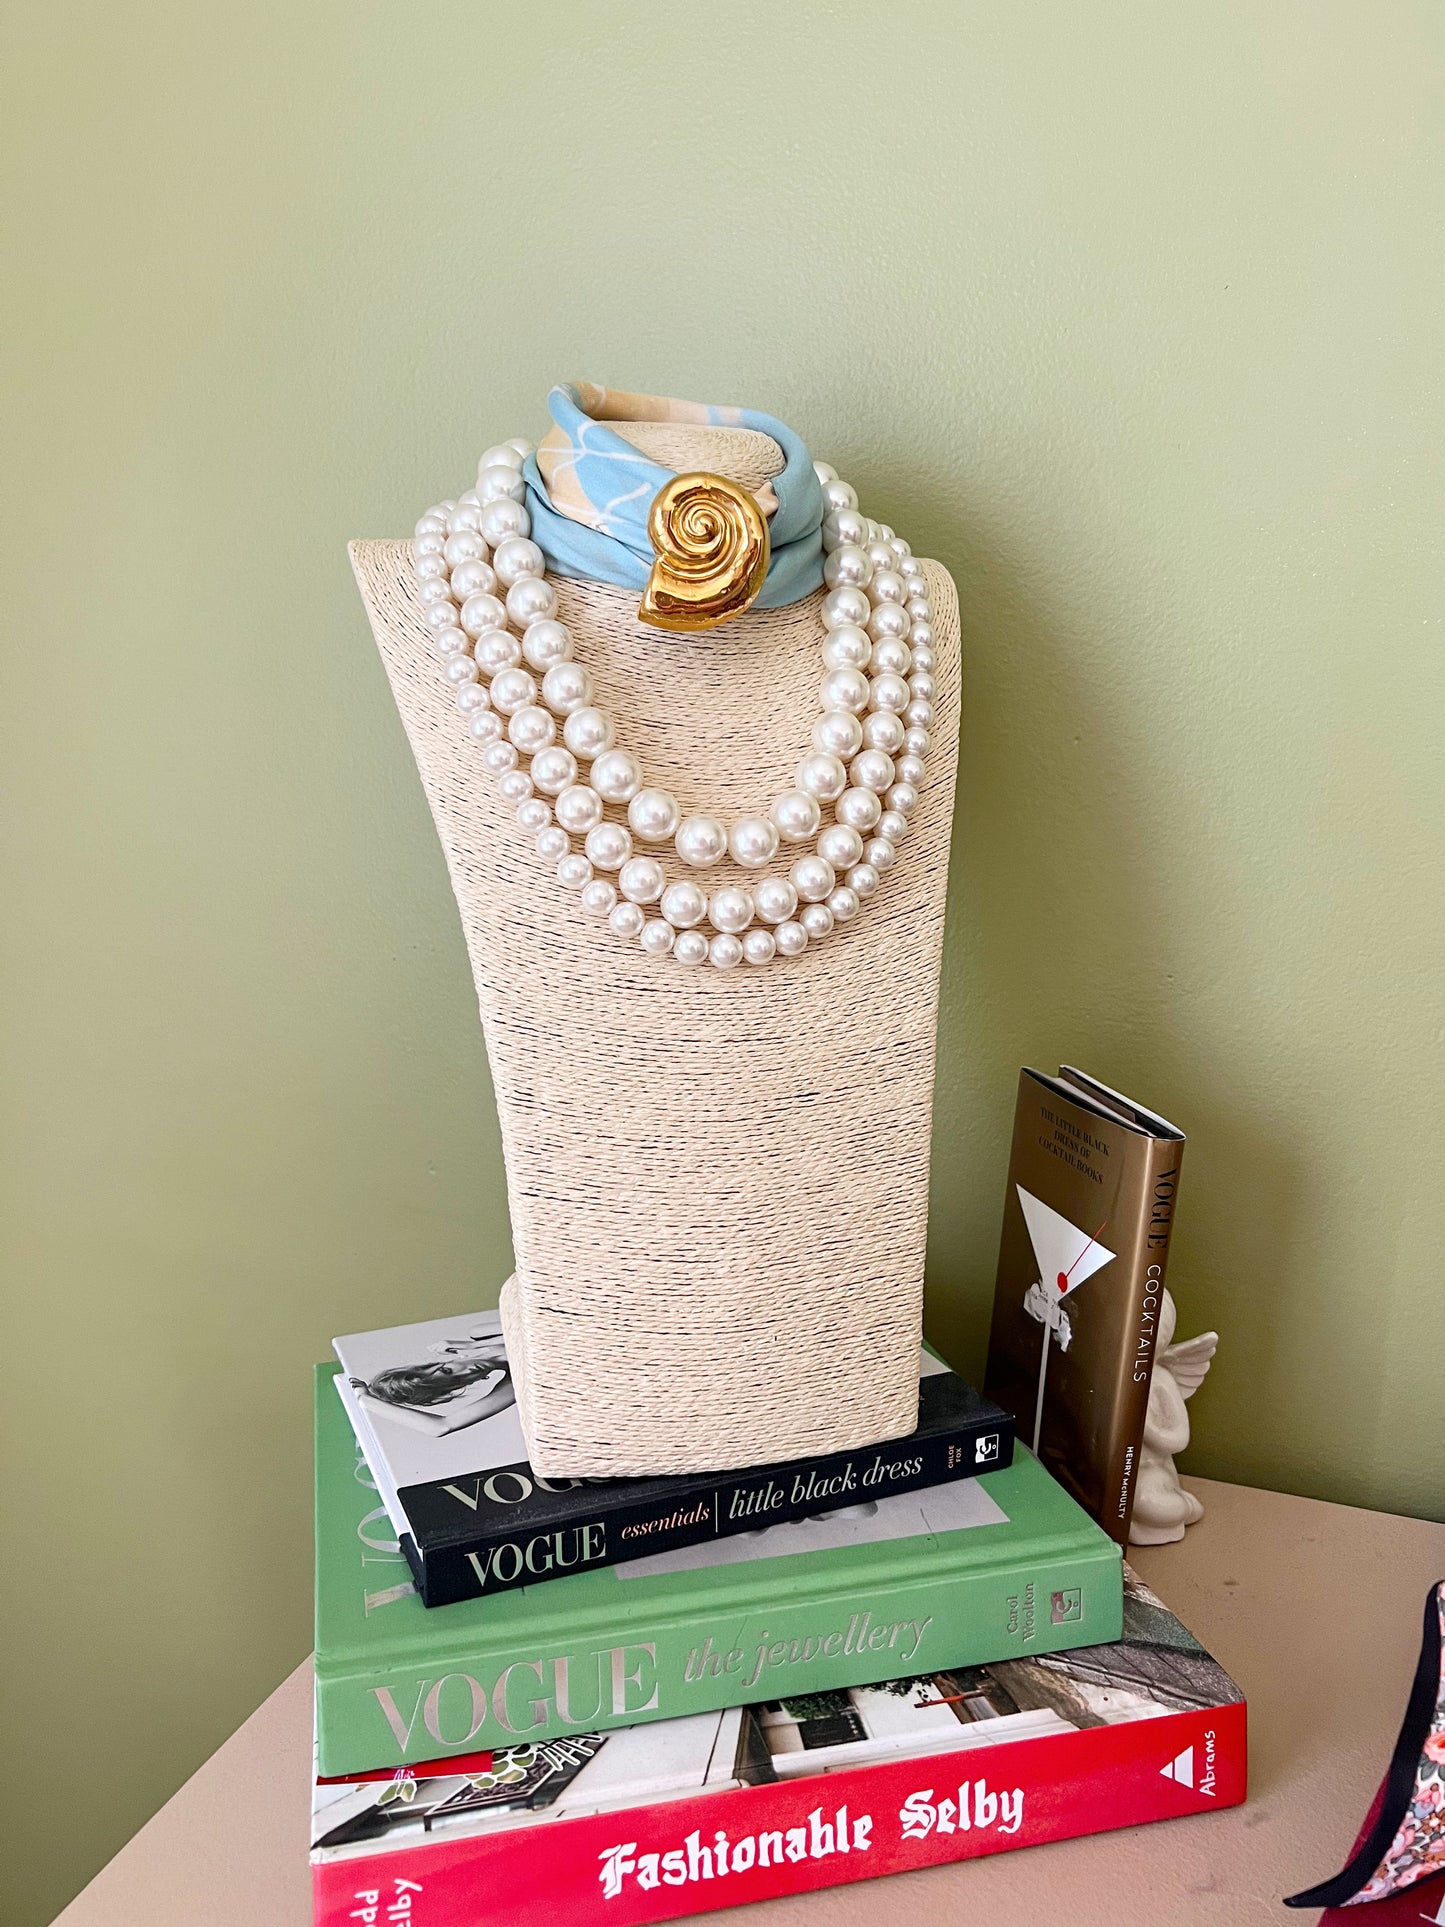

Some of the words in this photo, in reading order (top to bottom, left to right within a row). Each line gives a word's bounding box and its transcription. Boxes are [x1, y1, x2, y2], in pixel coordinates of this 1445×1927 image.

[1041, 1107, 1055, 1123] THE
[1055, 1116, 1081, 1139] LITTLE
[1083, 1131, 1111, 1156] BLACK
[1054, 1130, 1079, 1152] DRESS
[1080, 1146, 1091, 1159] OF
[1038, 1136, 1076, 1167] COCKTAIL
[1077, 1159, 1104, 1184] BOOKS
[1147, 1168, 1177, 1249] VOGUE
[1133, 1264, 1161, 1382] COCKTAILS
[1123, 1446, 1134, 1476] HENRY
[464, 1522, 607, 1587] VOGUE
[621, 1502, 710, 1540] essentials
[729, 1481, 784, 1520] little
[790, 1463, 857, 1504] black
[862, 1456, 923, 1487] dress
[1118, 1478, 1129, 1519] McNULTY
[1007, 1595, 1018, 1634] Carol
[1023, 1582, 1035, 1642] Woolton
[367, 1642, 660, 1754] VOGUE
[683, 1636, 744, 1682] the
[742, 1611, 933, 1687] jewellery
[1199, 1730, 1216, 1797] Abrams
[598, 1804, 873, 1900] Fashionable
[899, 1778, 1025, 1841] Selby
[349, 1889, 380, 1927] dd
